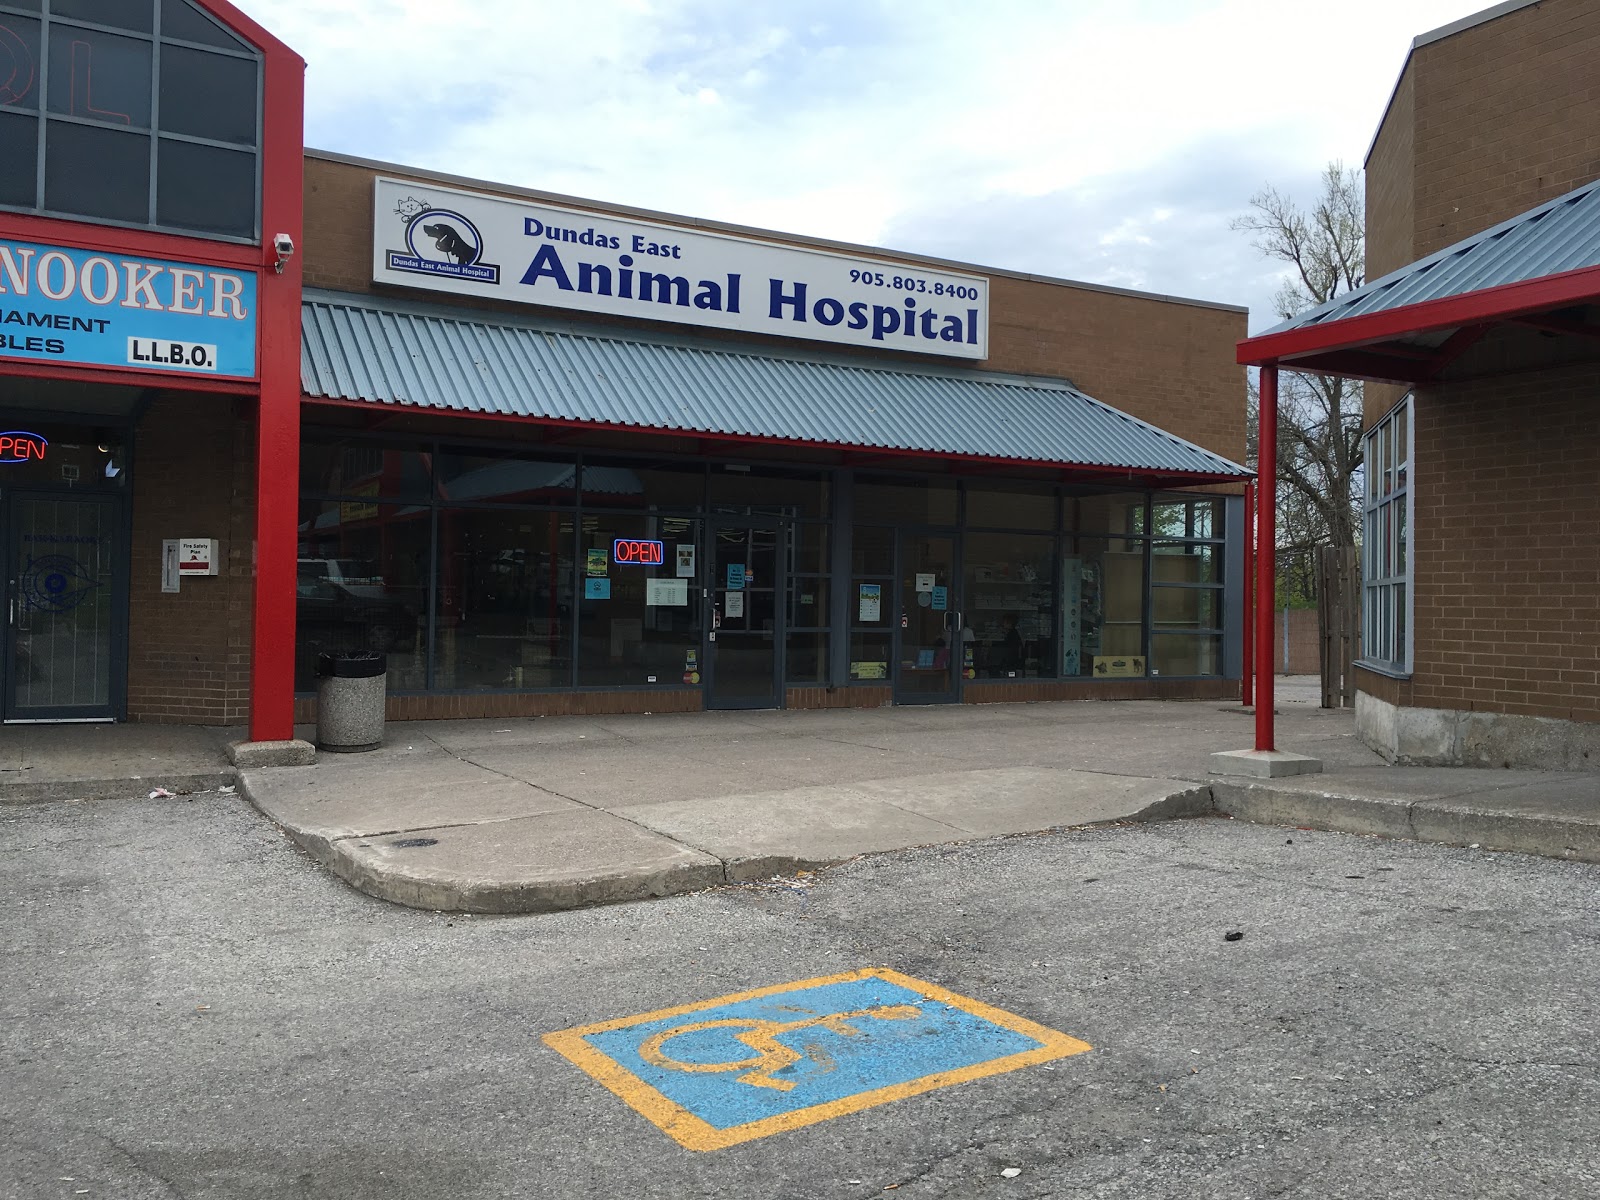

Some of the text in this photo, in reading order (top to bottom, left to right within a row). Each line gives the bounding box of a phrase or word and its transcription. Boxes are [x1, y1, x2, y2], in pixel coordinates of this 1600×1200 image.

[524, 217, 682, 259] Dundas East
[393, 258, 418, 267] Dundas
[437, 264, 460, 273] Animal
[463, 268, 489, 277] Hospital
[519, 244, 978, 345] Animal Hospital
[849, 269, 979, 301] 905.803.8400
[132, 341, 213, 367] L.L.B.O.
[617, 542, 661, 562] OPEN
